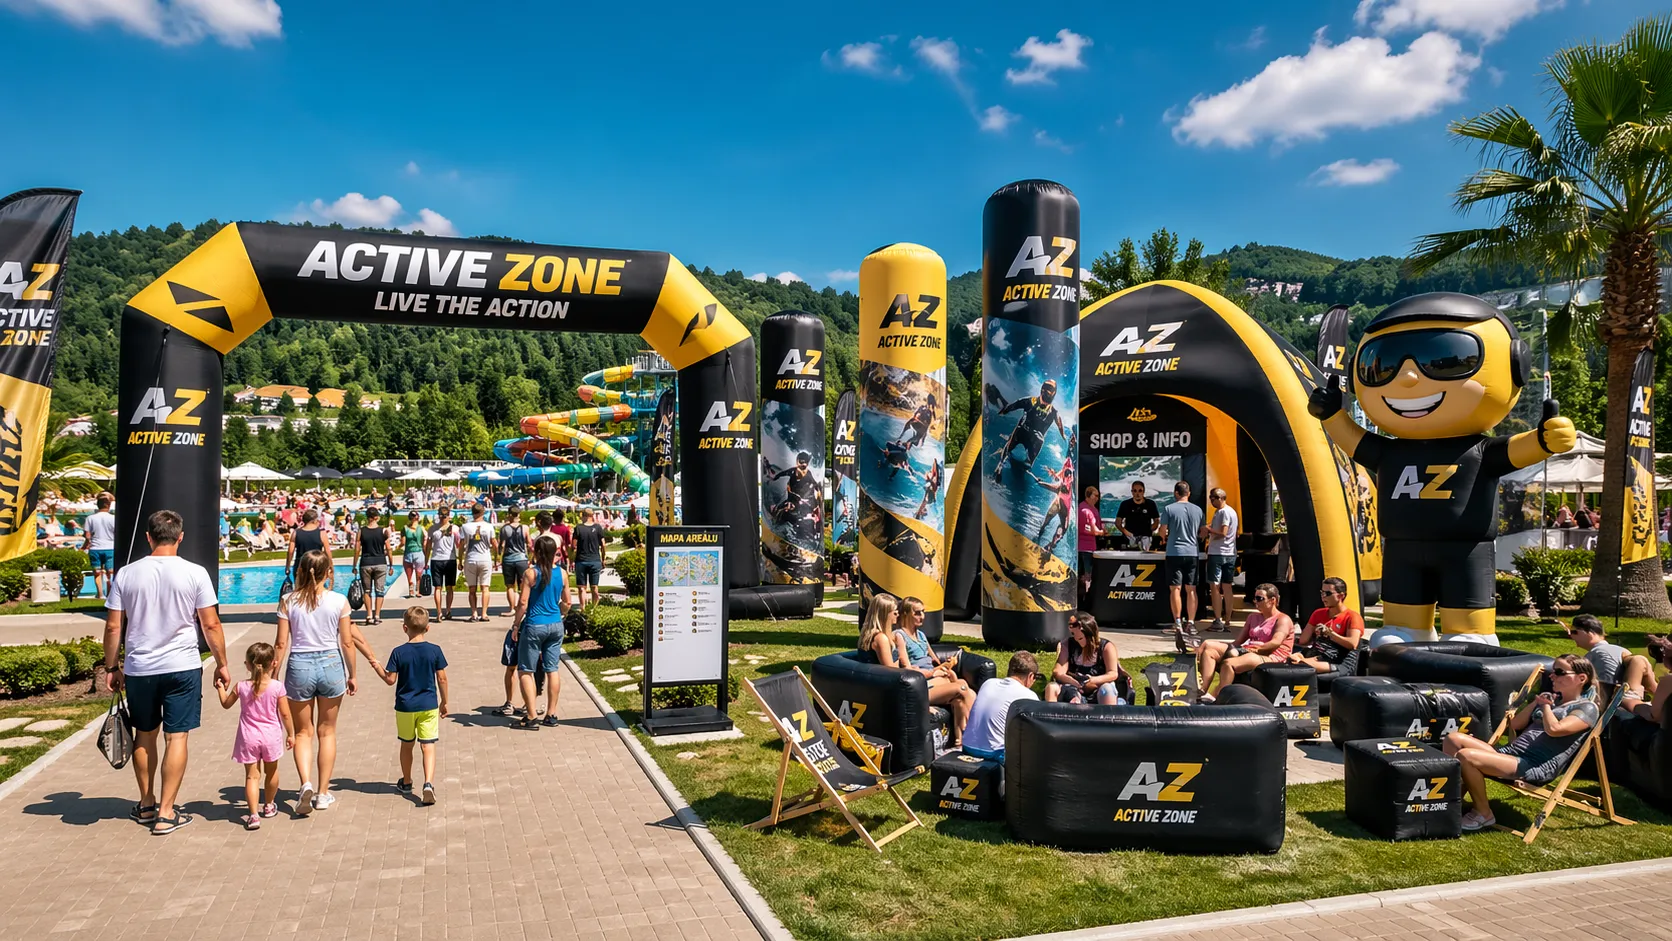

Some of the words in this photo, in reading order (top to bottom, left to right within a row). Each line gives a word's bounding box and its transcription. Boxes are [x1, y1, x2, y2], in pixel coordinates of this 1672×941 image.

[297, 240, 492, 289] ACTIVE
[498, 253, 626, 296] ZONE
[1004, 235, 1077, 278] AZ
[1003, 283, 1052, 301] ACTIVE
[1052, 284, 1077, 303] ZONE
[374, 291, 430, 313] LIVE
[436, 295, 482, 316] THE
[484, 298, 570, 320] ACTION
[879, 293, 941, 329] AZ
[877, 334, 919, 349] ACTIVE
[920, 335, 942, 350] ZONE
[1099, 321, 1184, 357] AZ
[777, 348, 822, 376] AZ
[1094, 360, 1142, 376] ACTIVE
[1142, 357, 1181, 373] ZONE
[1323, 344, 1346, 371] AZ
[775, 379, 806, 390] ACTIVE
[129, 387, 207, 426] AZ
[1631, 385, 1652, 415] AZ
[699, 400, 753, 432] AZ
[127, 431, 172, 445] ACTIVE
[172, 432, 206, 446] ZONE
[836, 419, 857, 441] AZ
[1089, 432, 1133, 449] SHOP
[1136, 432, 1149, 448] &
[1153, 431, 1192, 448] INFO
[698, 437, 734, 449] ACTIVE
[1391, 464, 1459, 499] AZ
[660, 533, 685, 543] MAPA
[1109, 564, 1157, 587] AZ
[1107, 590, 1134, 600] ACTIVE
[1134, 591, 1156, 600] ZONE
[1273, 685, 1309, 707] AZ
[838, 700, 867, 729] AZ
[940, 775, 980, 800] AZ
[1117, 762, 1203, 802] AZ
[1407, 777, 1448, 800] AZ
[1113, 808, 1161, 823] ACTIVE
[1161, 809, 1198, 824] ZONE
[1405, 804, 1430, 813] ACTIVE
